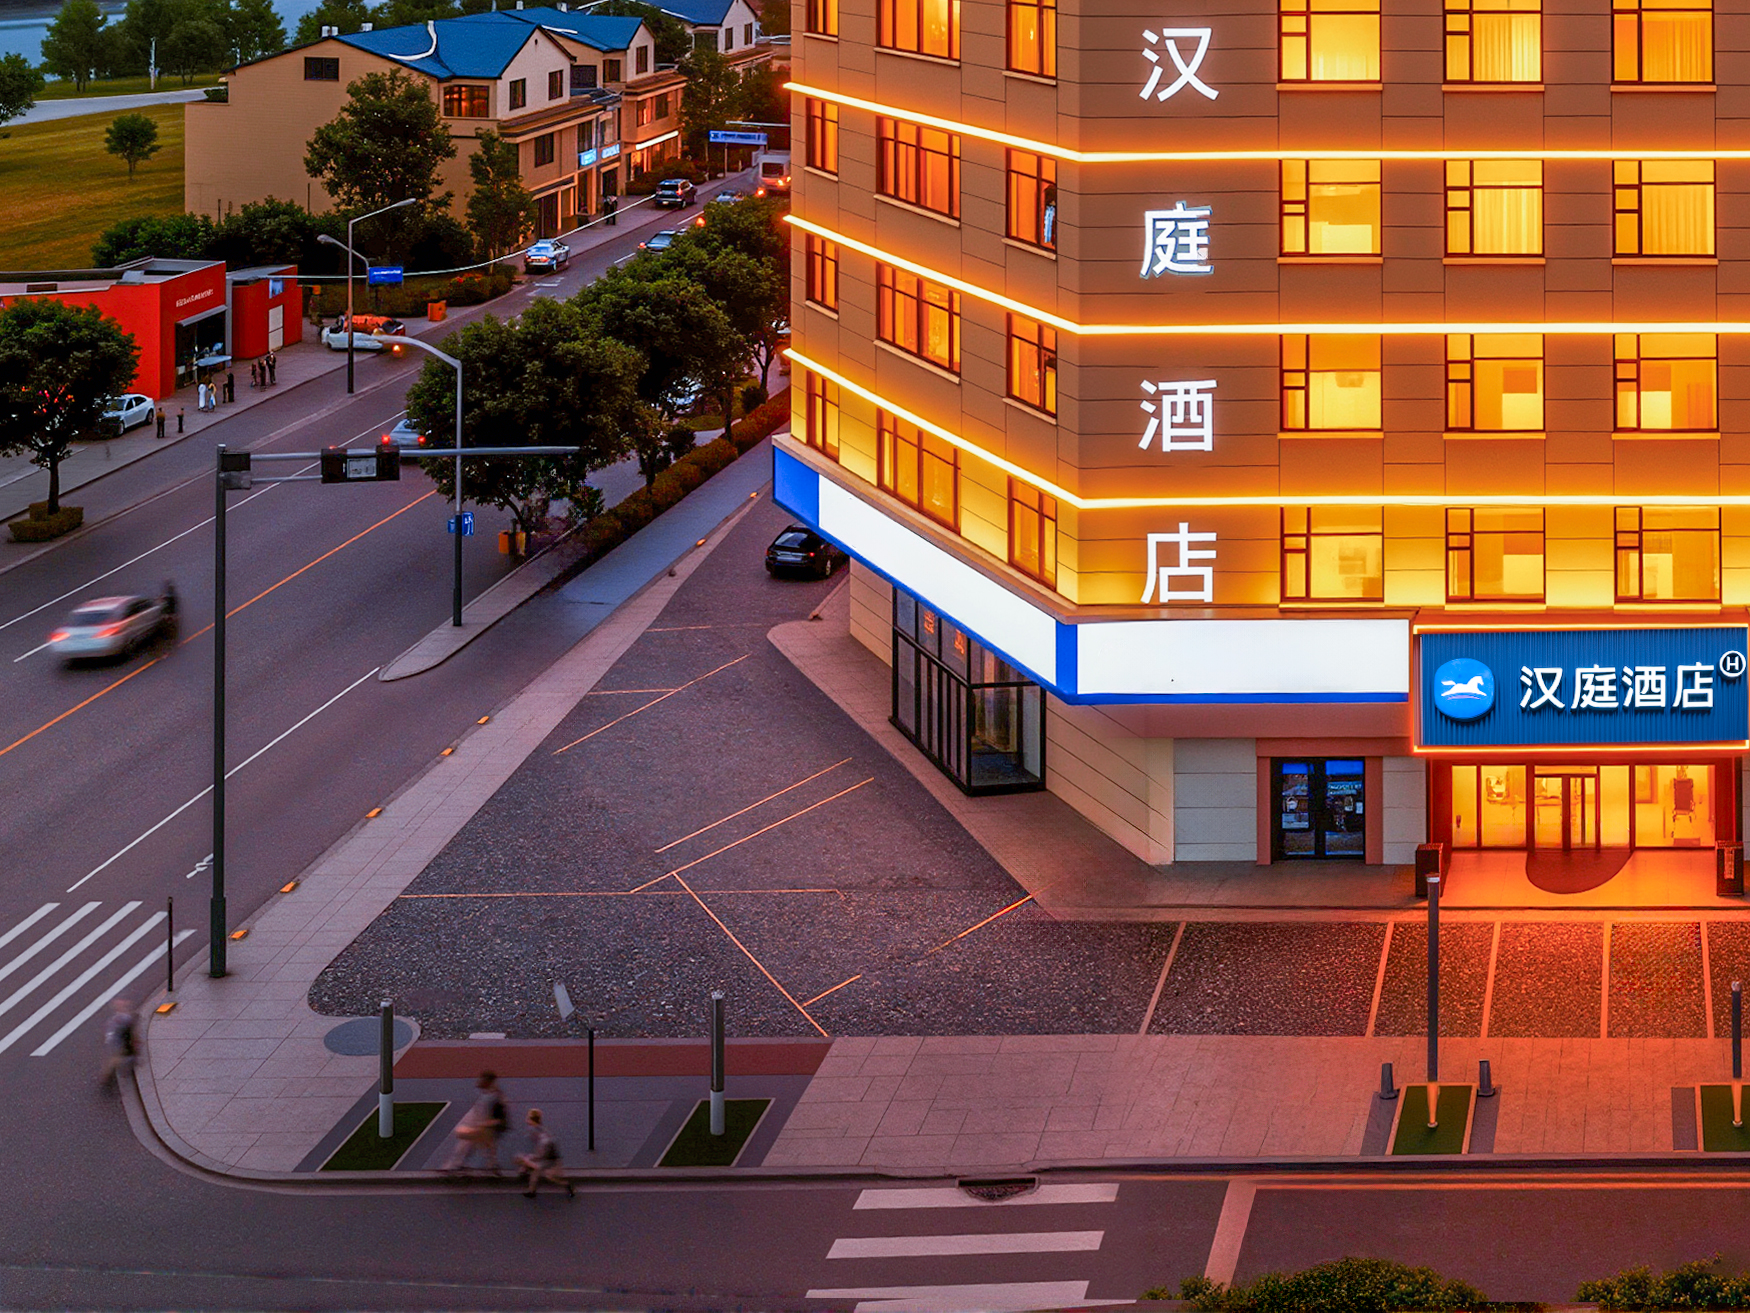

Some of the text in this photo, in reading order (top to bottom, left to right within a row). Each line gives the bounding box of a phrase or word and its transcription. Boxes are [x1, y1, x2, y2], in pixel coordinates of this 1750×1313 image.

[1139, 26, 1219, 604] 汉庭酒店
[1519, 662, 1714, 709] 汉庭酒店
